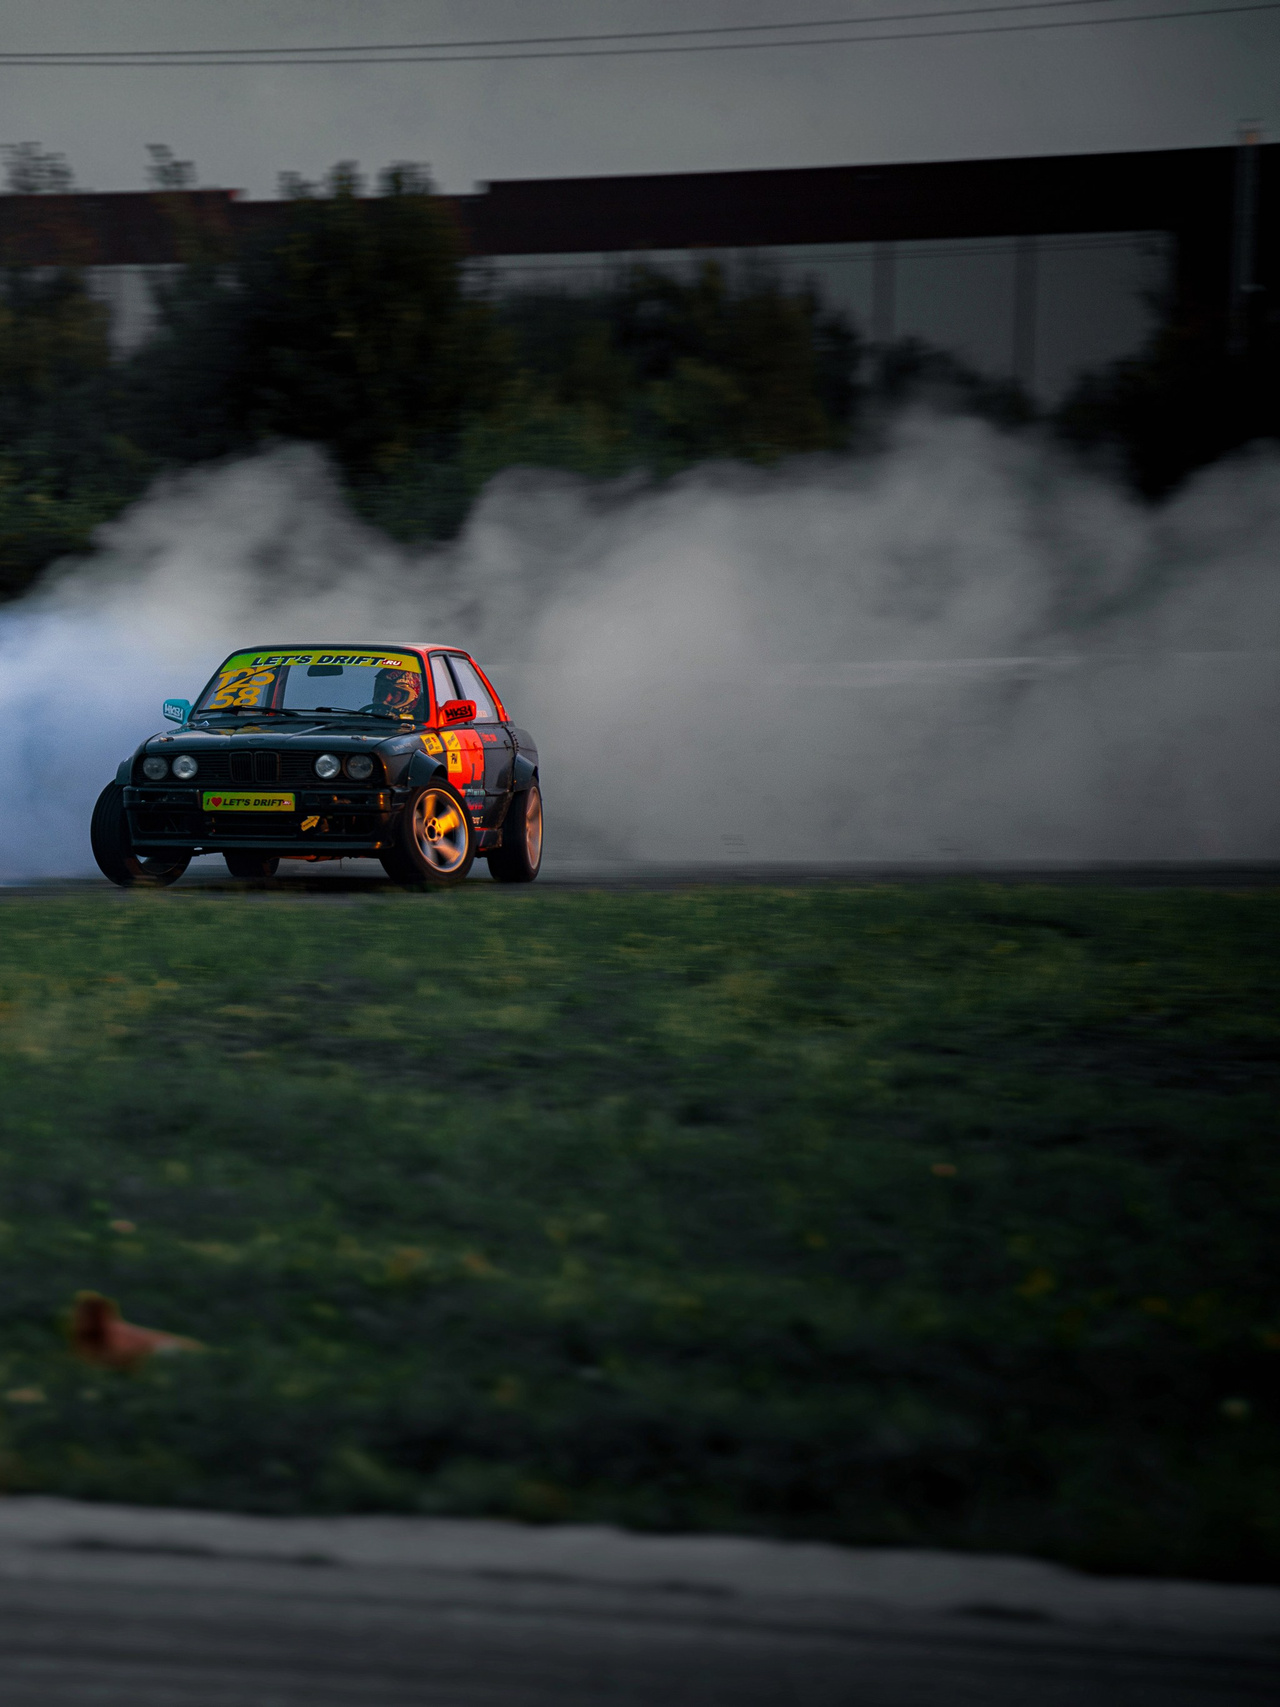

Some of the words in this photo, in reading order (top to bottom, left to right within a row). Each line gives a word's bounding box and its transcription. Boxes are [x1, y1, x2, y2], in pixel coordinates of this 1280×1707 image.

[251, 655, 314, 667] LET'S
[216, 665, 276, 690] T25
[209, 686, 261, 709] 58
[222, 798, 251, 806] LET'S
